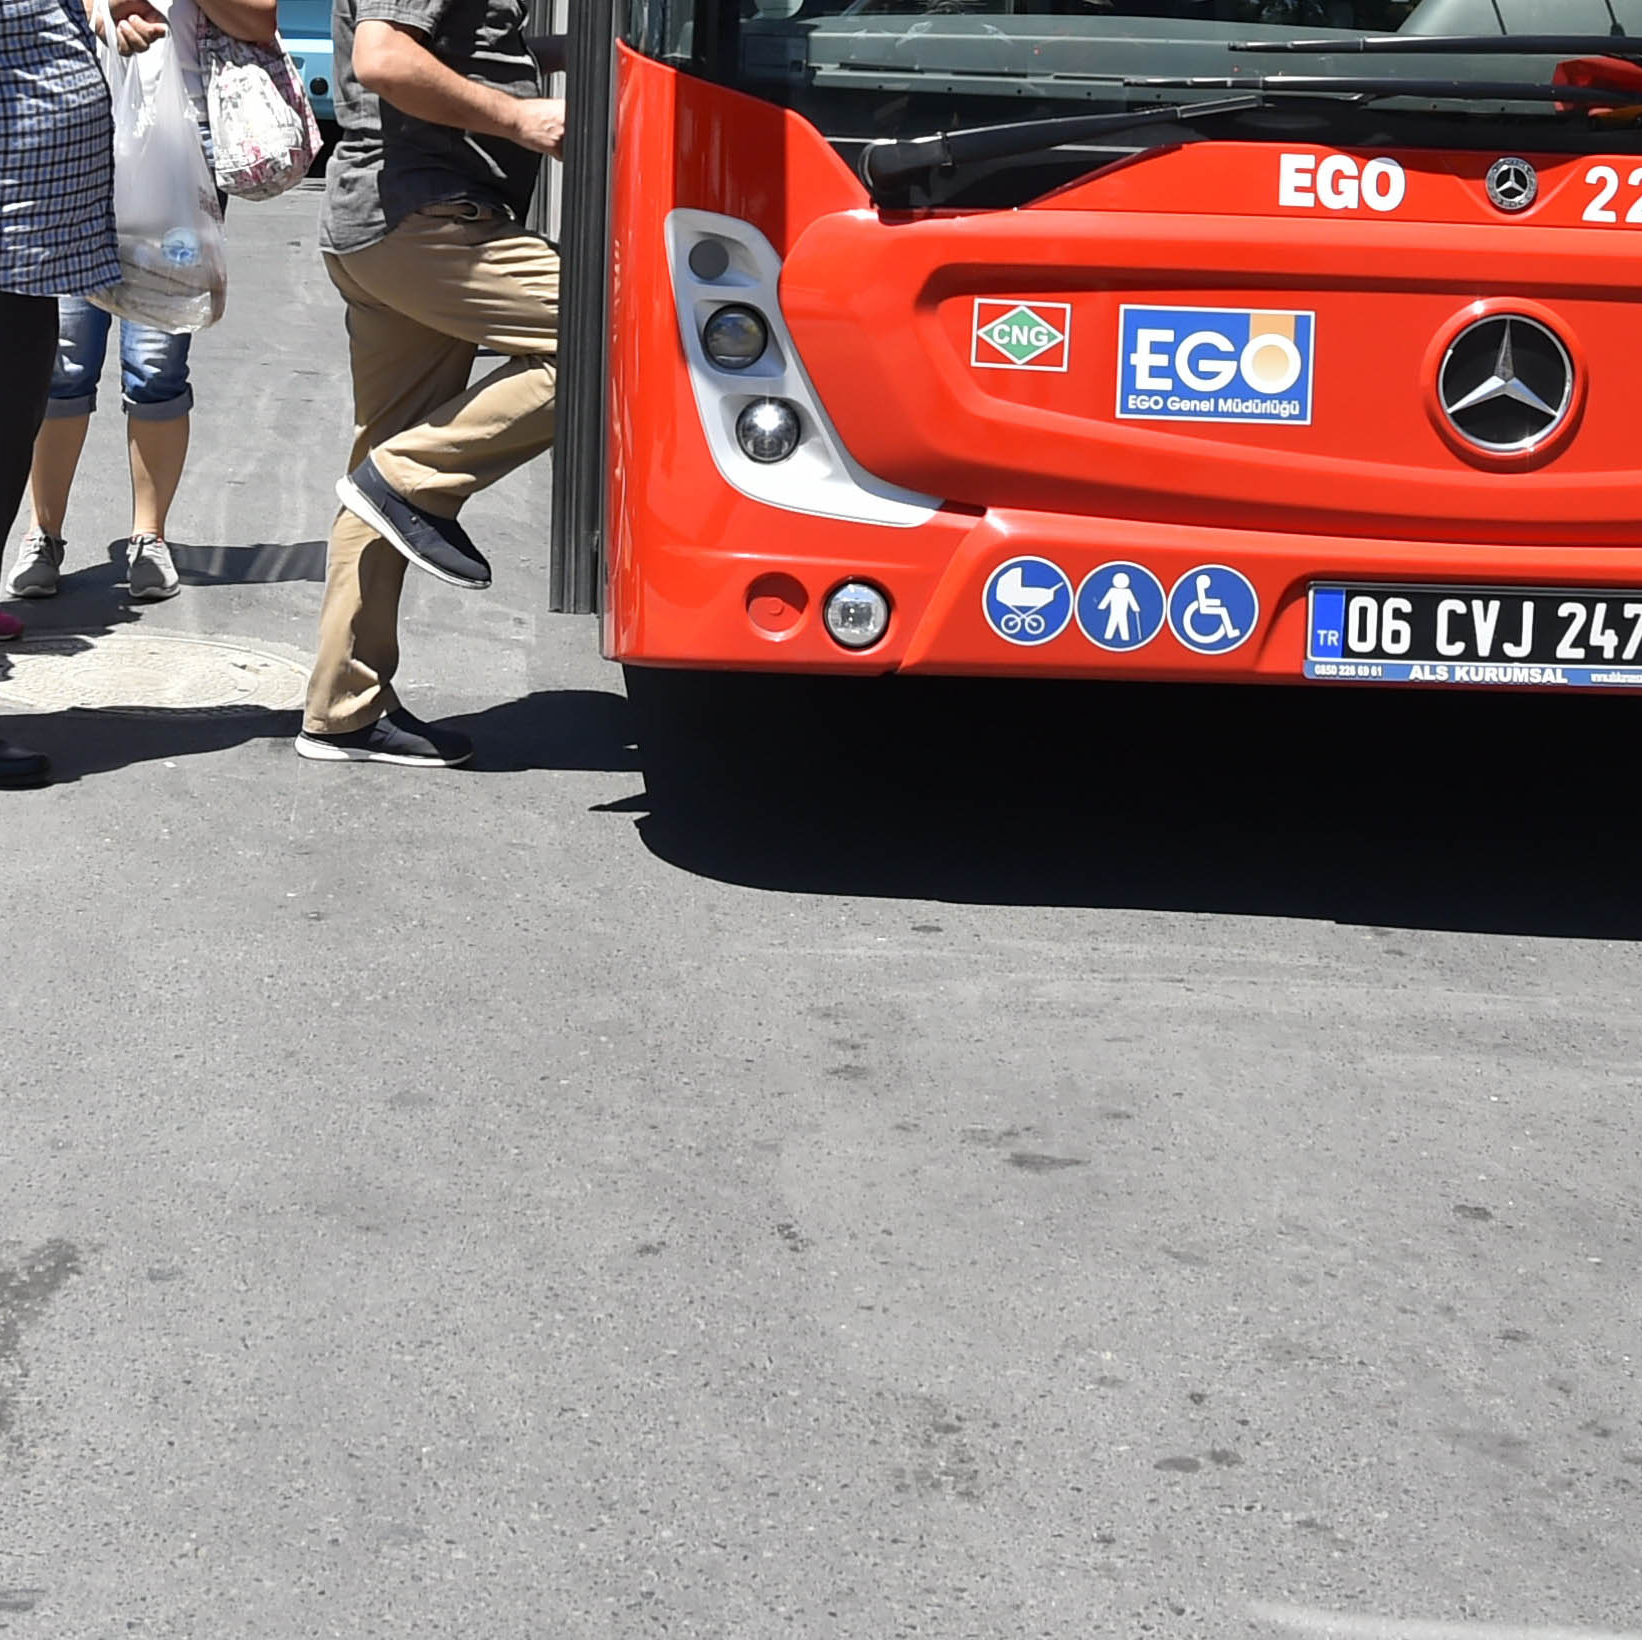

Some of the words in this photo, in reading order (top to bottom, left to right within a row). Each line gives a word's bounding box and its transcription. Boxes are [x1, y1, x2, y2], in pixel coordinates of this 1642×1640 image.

[1277, 153, 1407, 212] EGO
[992, 324, 1050, 347] CNG
[1129, 328, 1302, 394] EGO
[1127, 394, 1164, 410] EGO
[1167, 396, 1214, 412] Genel
[1217, 397, 1301, 418] Müdürlüğü
[1317, 630, 1339, 647] TR
[1347, 595, 1413, 655] 06
[1435, 599, 1535, 658] CVJ
[1408, 665, 1450, 682] ALS
[1454, 666, 1569, 684] KURUMSAL
